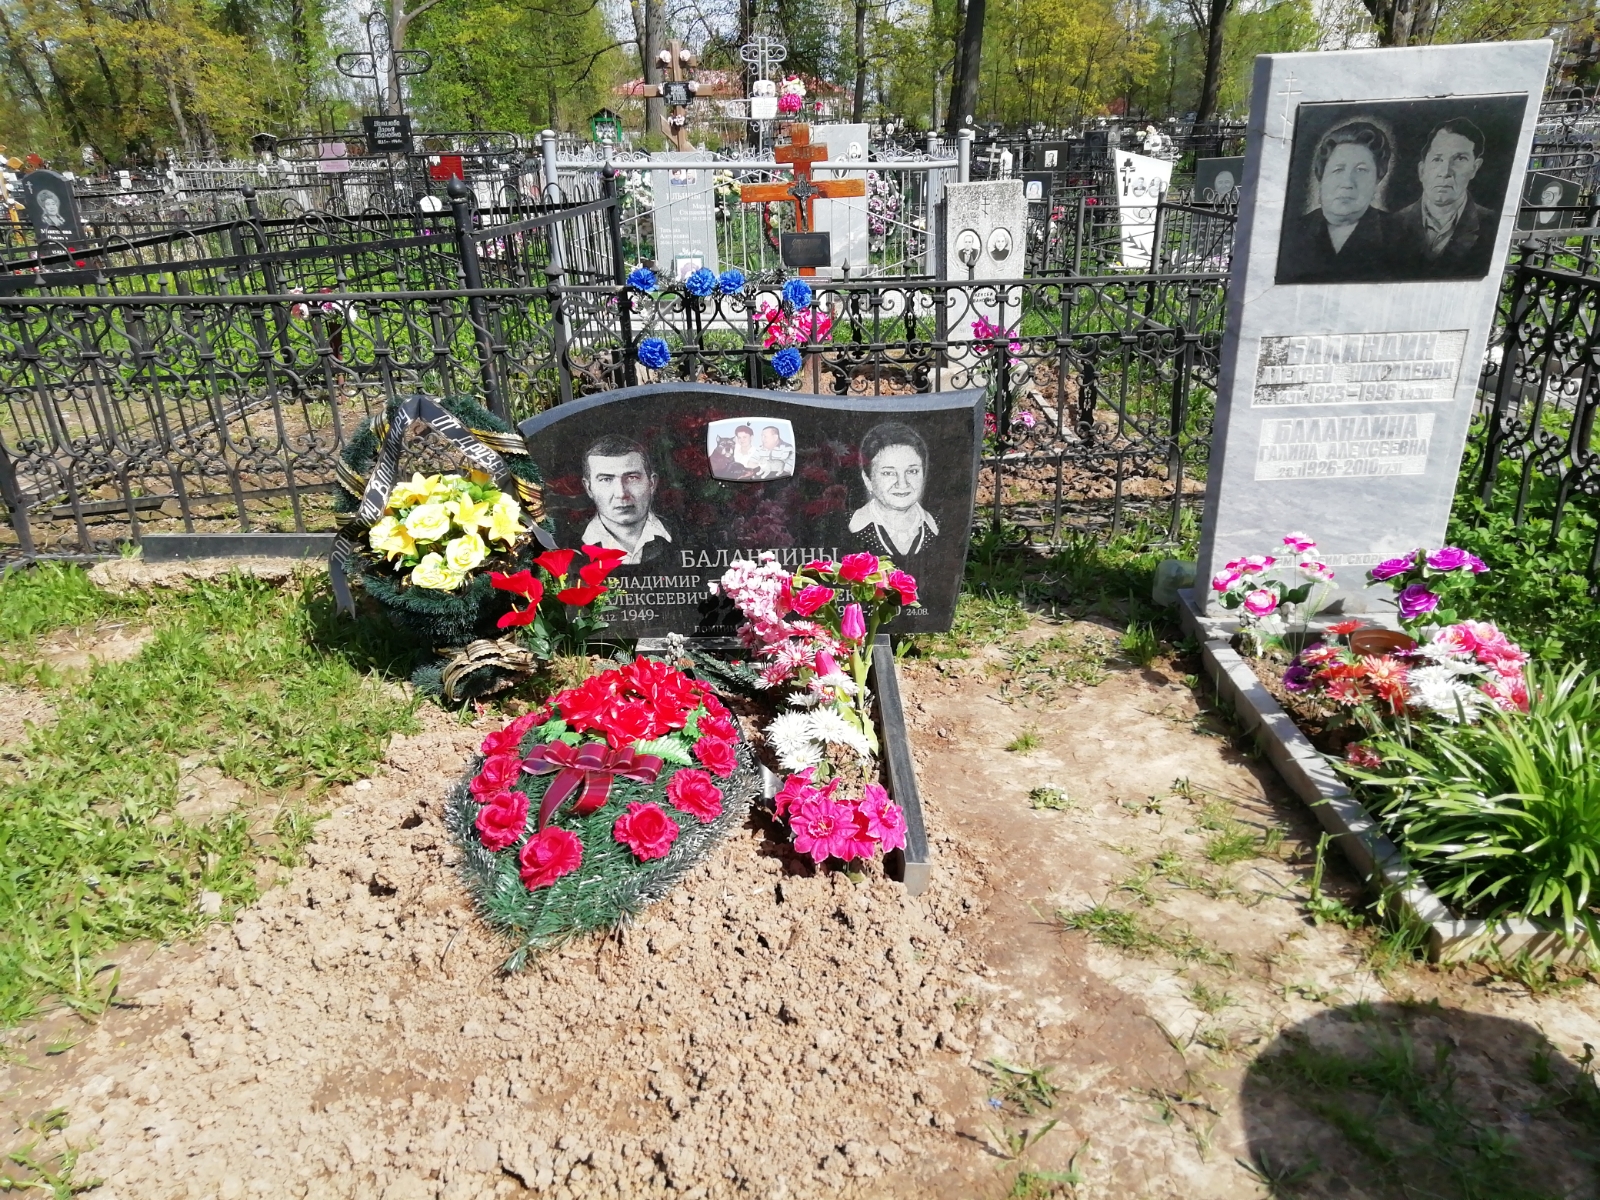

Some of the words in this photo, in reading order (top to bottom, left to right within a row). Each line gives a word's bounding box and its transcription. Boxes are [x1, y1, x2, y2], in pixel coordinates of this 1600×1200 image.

[431, 415, 462, 431] ОТ
[1274, 413, 1419, 444] БАЛАНДИНА
[1259, 442, 1319, 462] ГАЛИНА
[1326, 438, 1429, 460] АЛЕКСЕЕВНА
[606, 575, 701, 590] ВЛАДИМИР
[620, 609, 660, 622] 1949-
